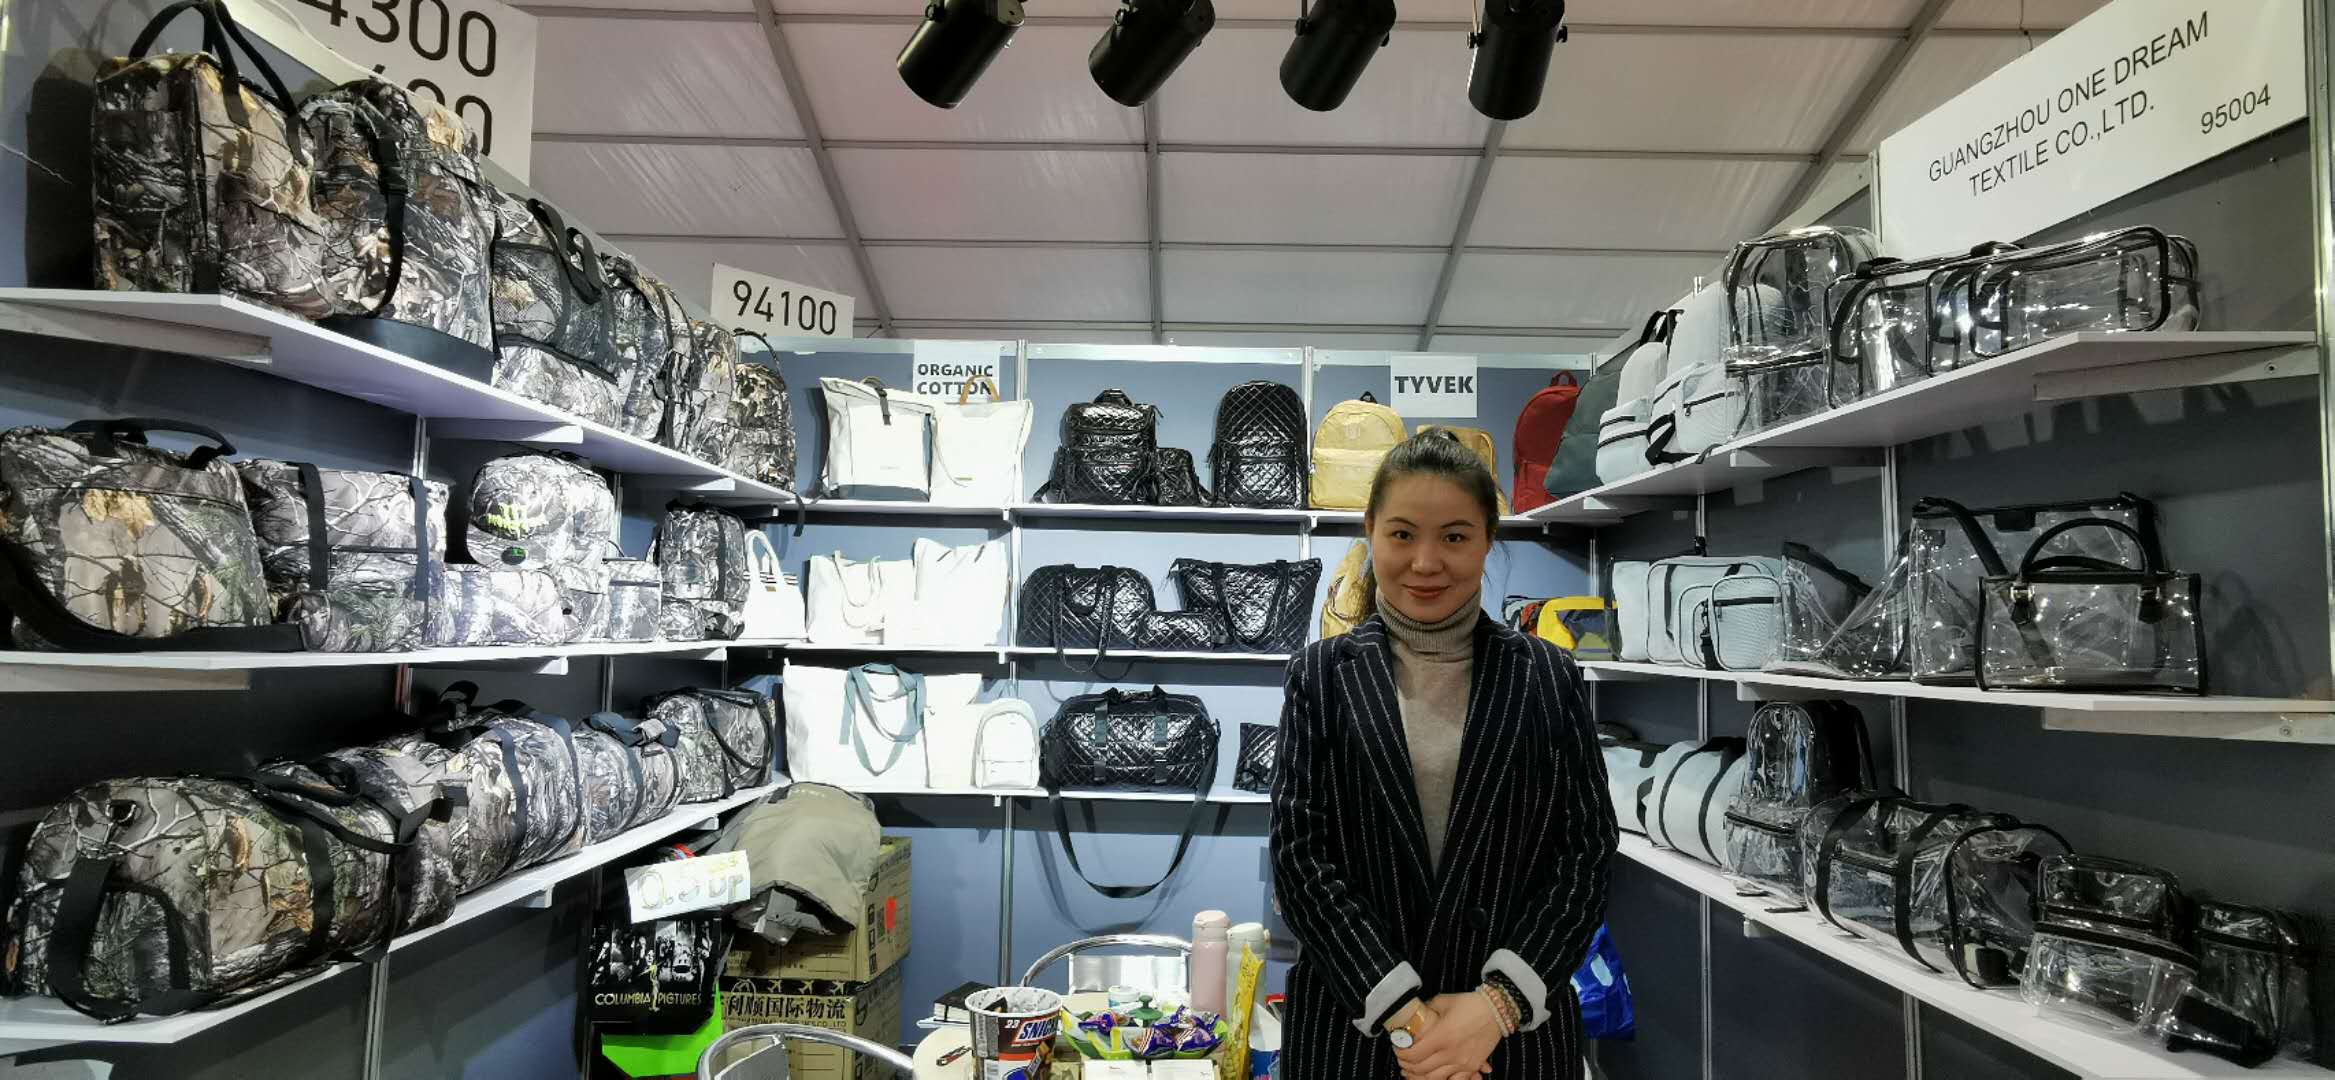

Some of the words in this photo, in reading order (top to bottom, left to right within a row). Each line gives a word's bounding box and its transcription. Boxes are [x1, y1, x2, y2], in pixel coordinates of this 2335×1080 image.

[1929, 98, 2050, 182] GUANGZHOU
[2057, 68, 2107, 114] ONE
[2114, 10, 2209, 85] DREAM
[2201, 83, 2272, 135] 95004
[1969, 139, 2050, 197] TEXTILE
[733, 280, 837, 335] 94100
[917, 363, 993, 377] ORGANIC
[1394, 375, 1474, 394] TYVEK
[917, 381, 992, 395] COTTON
[594, 993, 651, 1006] COLUMBIA
[657, 993, 702, 1005] PICTURES
